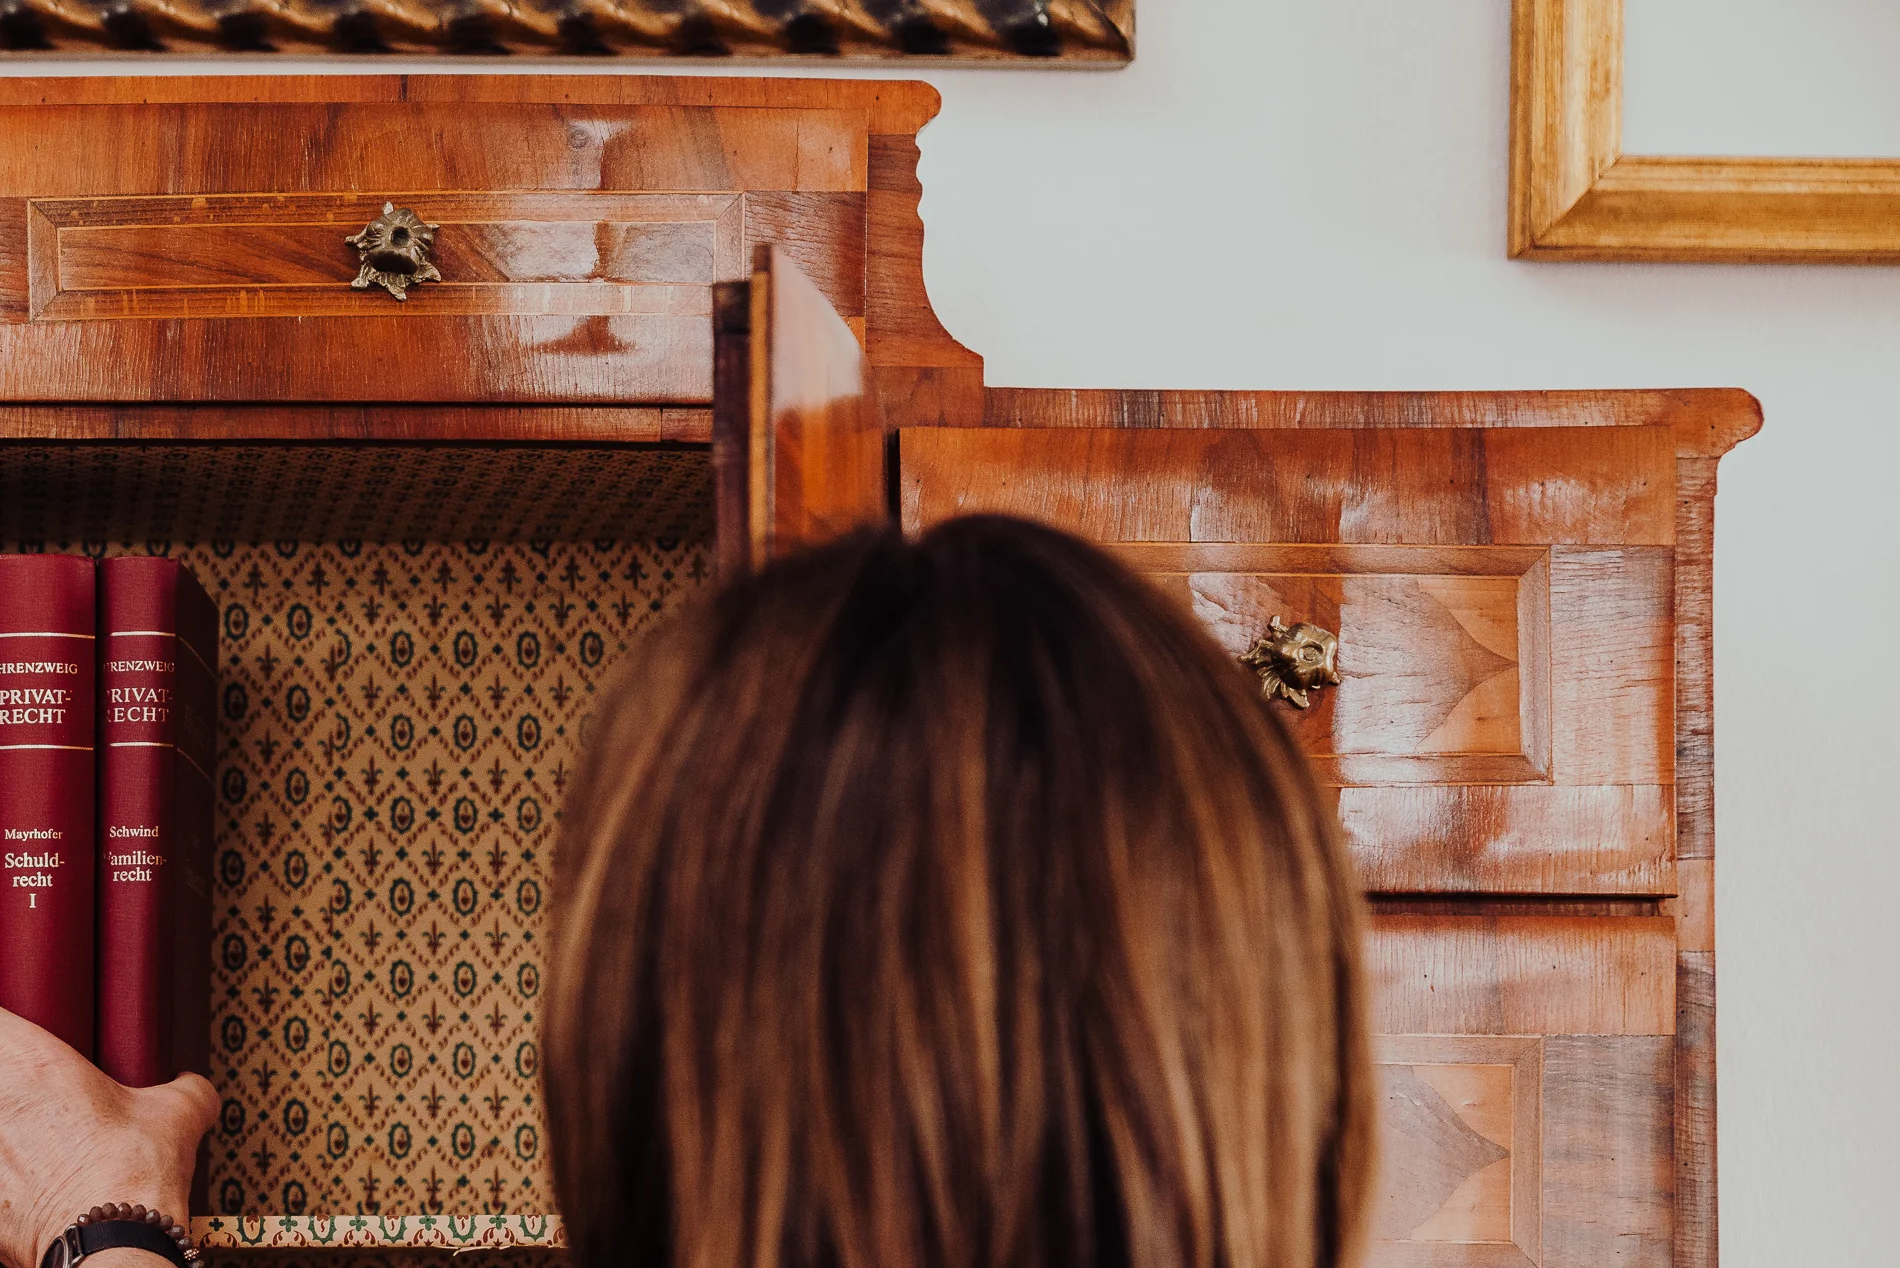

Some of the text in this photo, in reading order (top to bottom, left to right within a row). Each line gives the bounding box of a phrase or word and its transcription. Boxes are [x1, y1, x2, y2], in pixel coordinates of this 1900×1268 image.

[103, 660, 175, 673] RENZWEIG
[106, 687, 173, 704] RIVAT-
[4, 828, 64, 842] Mayrhofer
[109, 825, 160, 838] Schwind
[4, 851, 66, 869] Schuld-
[103, 850, 167, 866] amilien-
[12, 871, 54, 888] recht
[112, 866, 153, 882] recht
[28, 892, 38, 909] I
